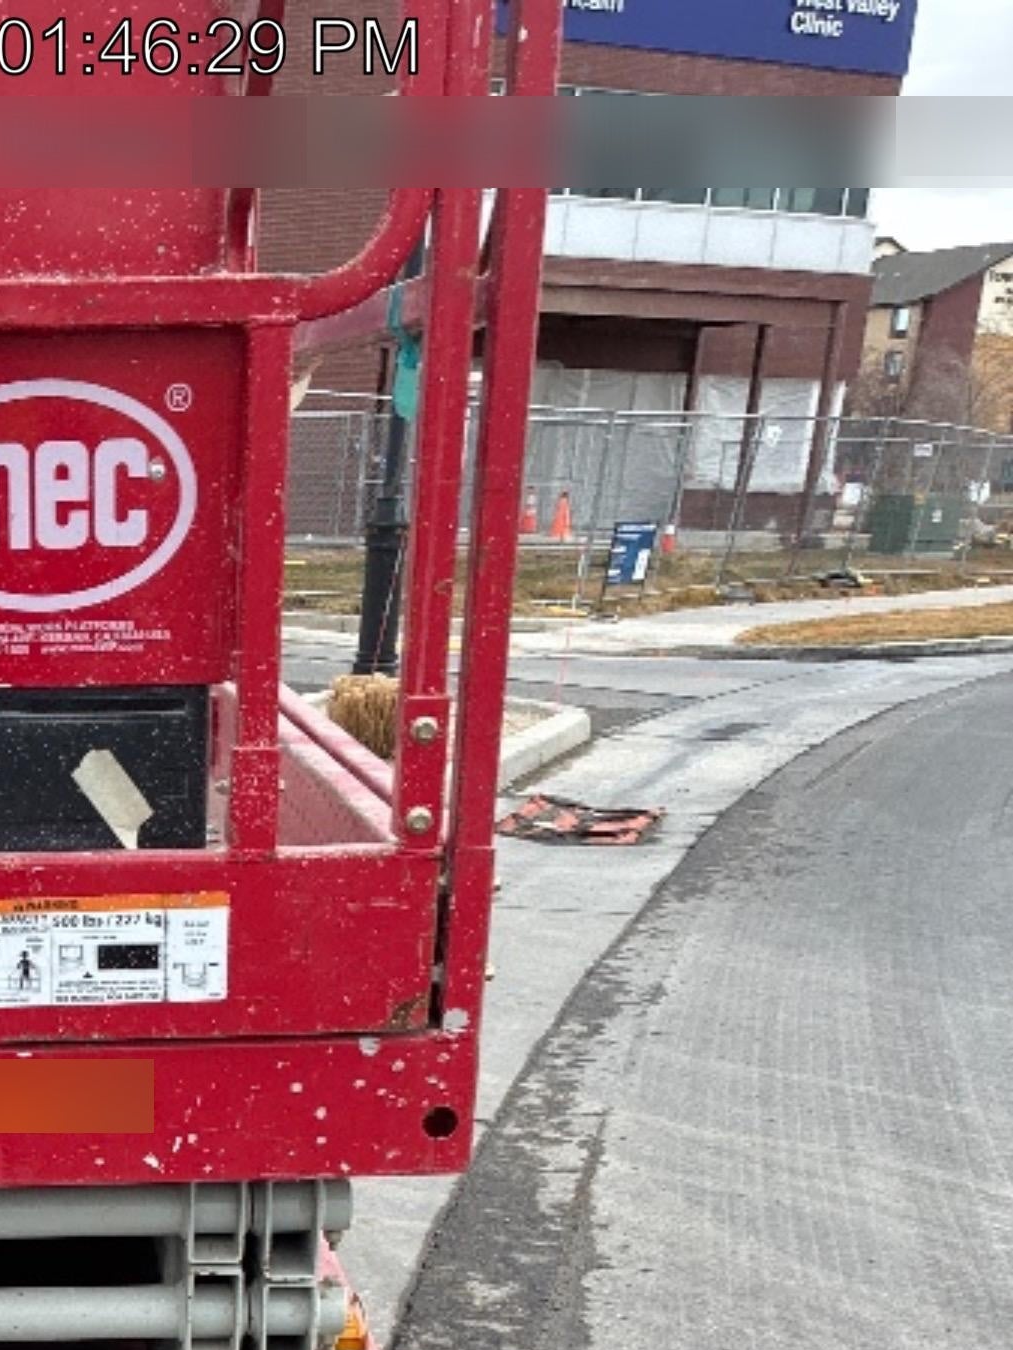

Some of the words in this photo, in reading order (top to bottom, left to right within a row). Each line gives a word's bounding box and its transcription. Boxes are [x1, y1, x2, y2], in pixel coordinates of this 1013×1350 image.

[848, 0, 900, 22] Valley
[791, 11, 843, 37] Clinic
[52, 914, 79, 928] 500
[83, 914, 105, 928] lbs
[115, 913, 142, 926] 227
[145, 912, 163, 928] kg
